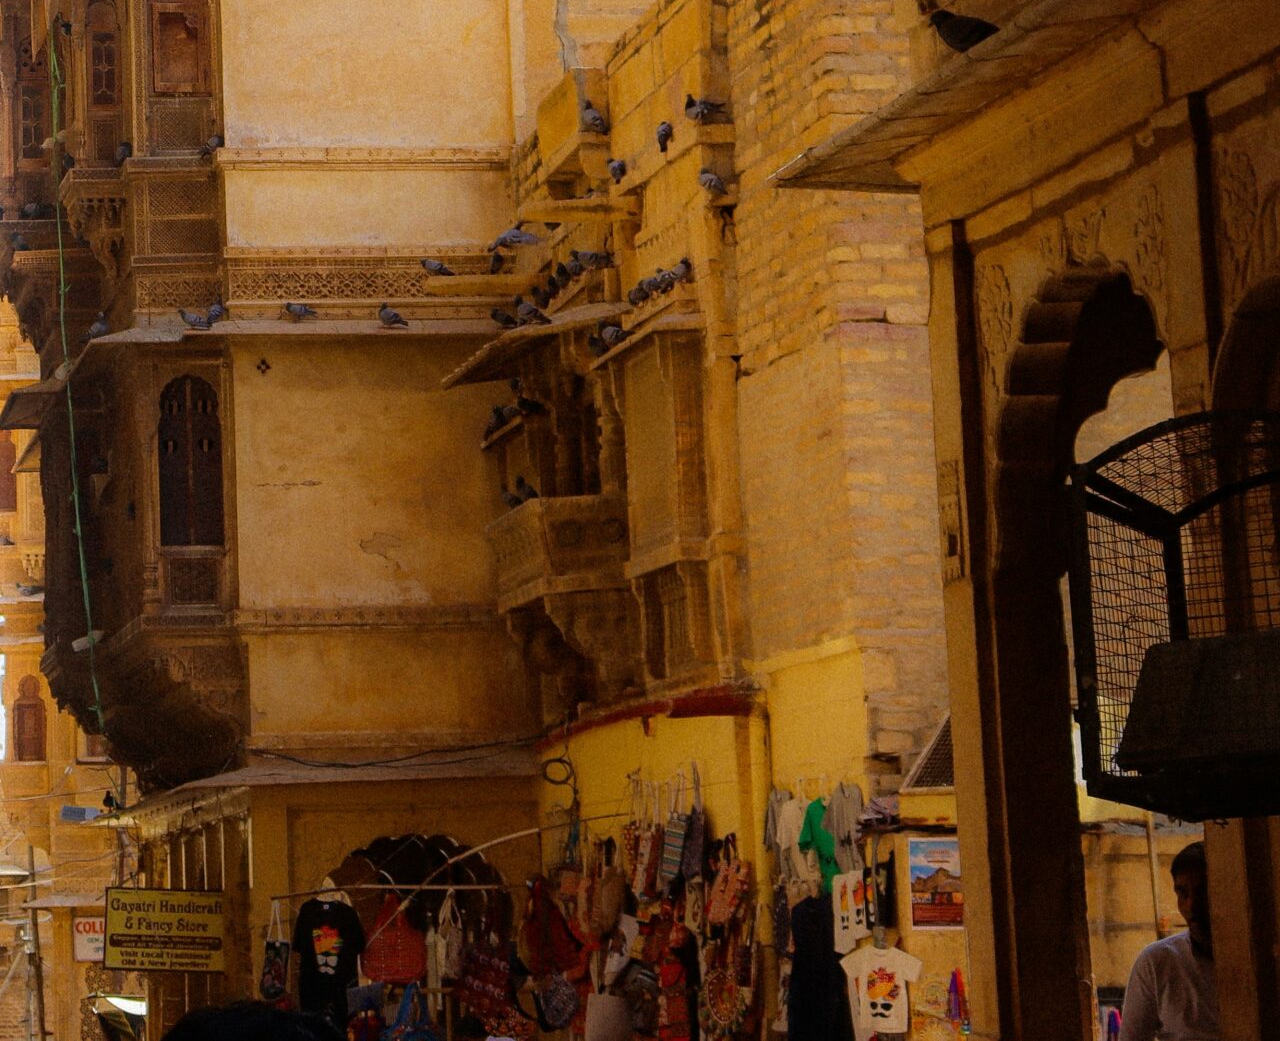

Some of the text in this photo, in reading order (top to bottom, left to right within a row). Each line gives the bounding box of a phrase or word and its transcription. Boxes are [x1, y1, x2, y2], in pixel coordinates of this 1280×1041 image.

[111, 898, 223, 915] Gayatri Handicraft
[124, 917, 209, 933] & Fancy Store
